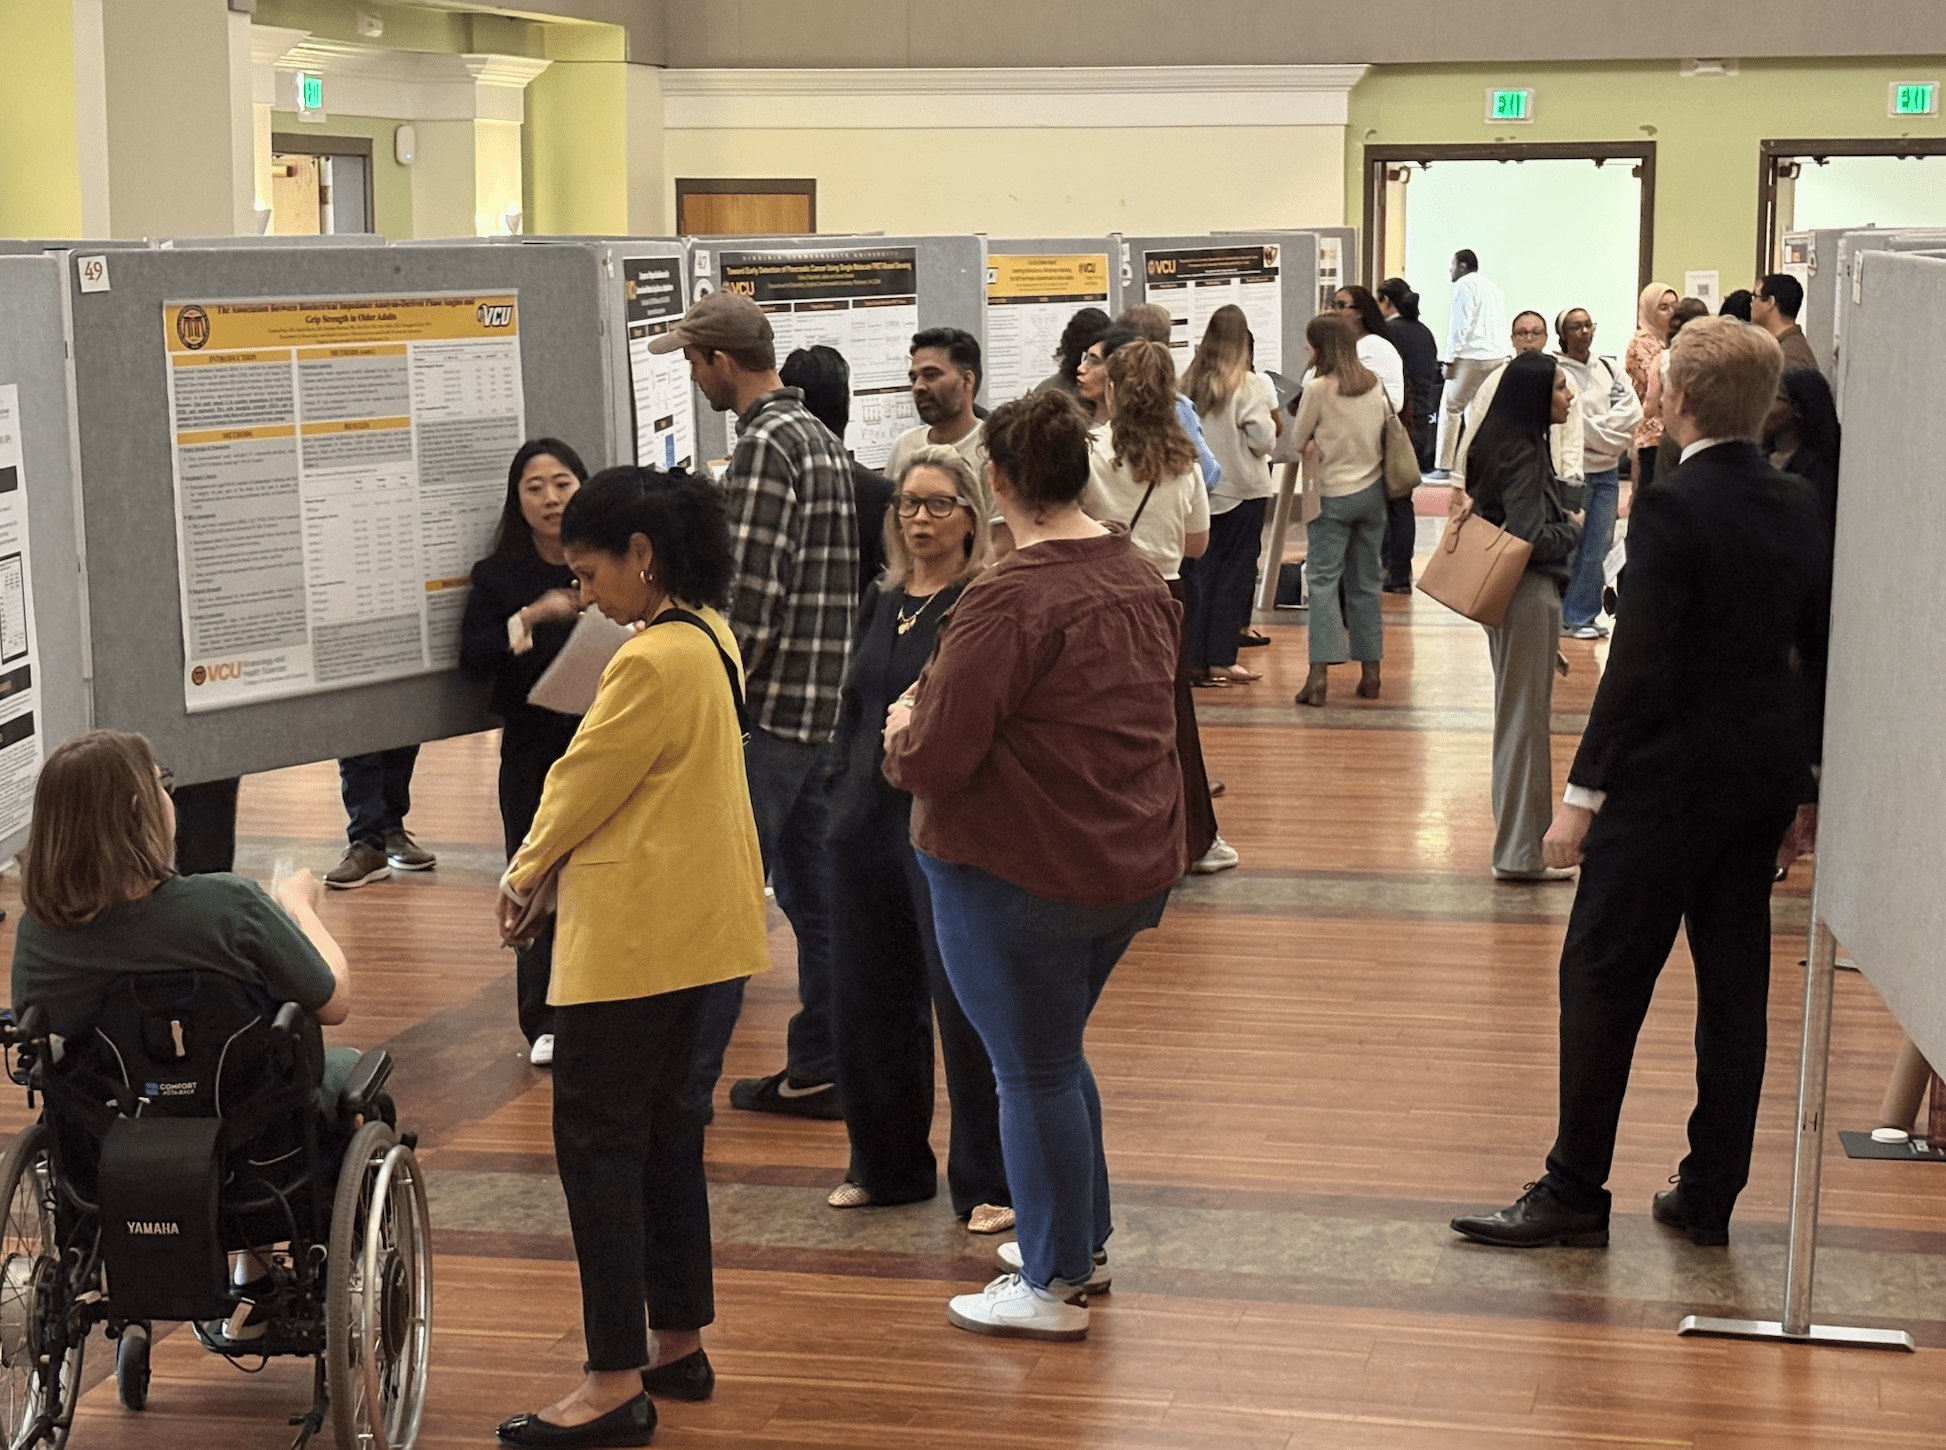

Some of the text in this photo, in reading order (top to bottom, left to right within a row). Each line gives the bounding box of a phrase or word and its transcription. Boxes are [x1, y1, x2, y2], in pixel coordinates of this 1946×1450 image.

[84, 261, 103, 282] 49
[1155, 259, 1177, 274] VCU
[730, 280, 756, 297] VCU
[305, 314, 321, 325] Grip
[322, 313, 349, 325] Strength
[358, 311, 377, 322] Older
[482, 304, 514, 328] VCU
[207, 661, 242, 682] VCU
[160, 1081, 198, 1091] COMFORT
[126, 1220, 180, 1235] YAMAHA
